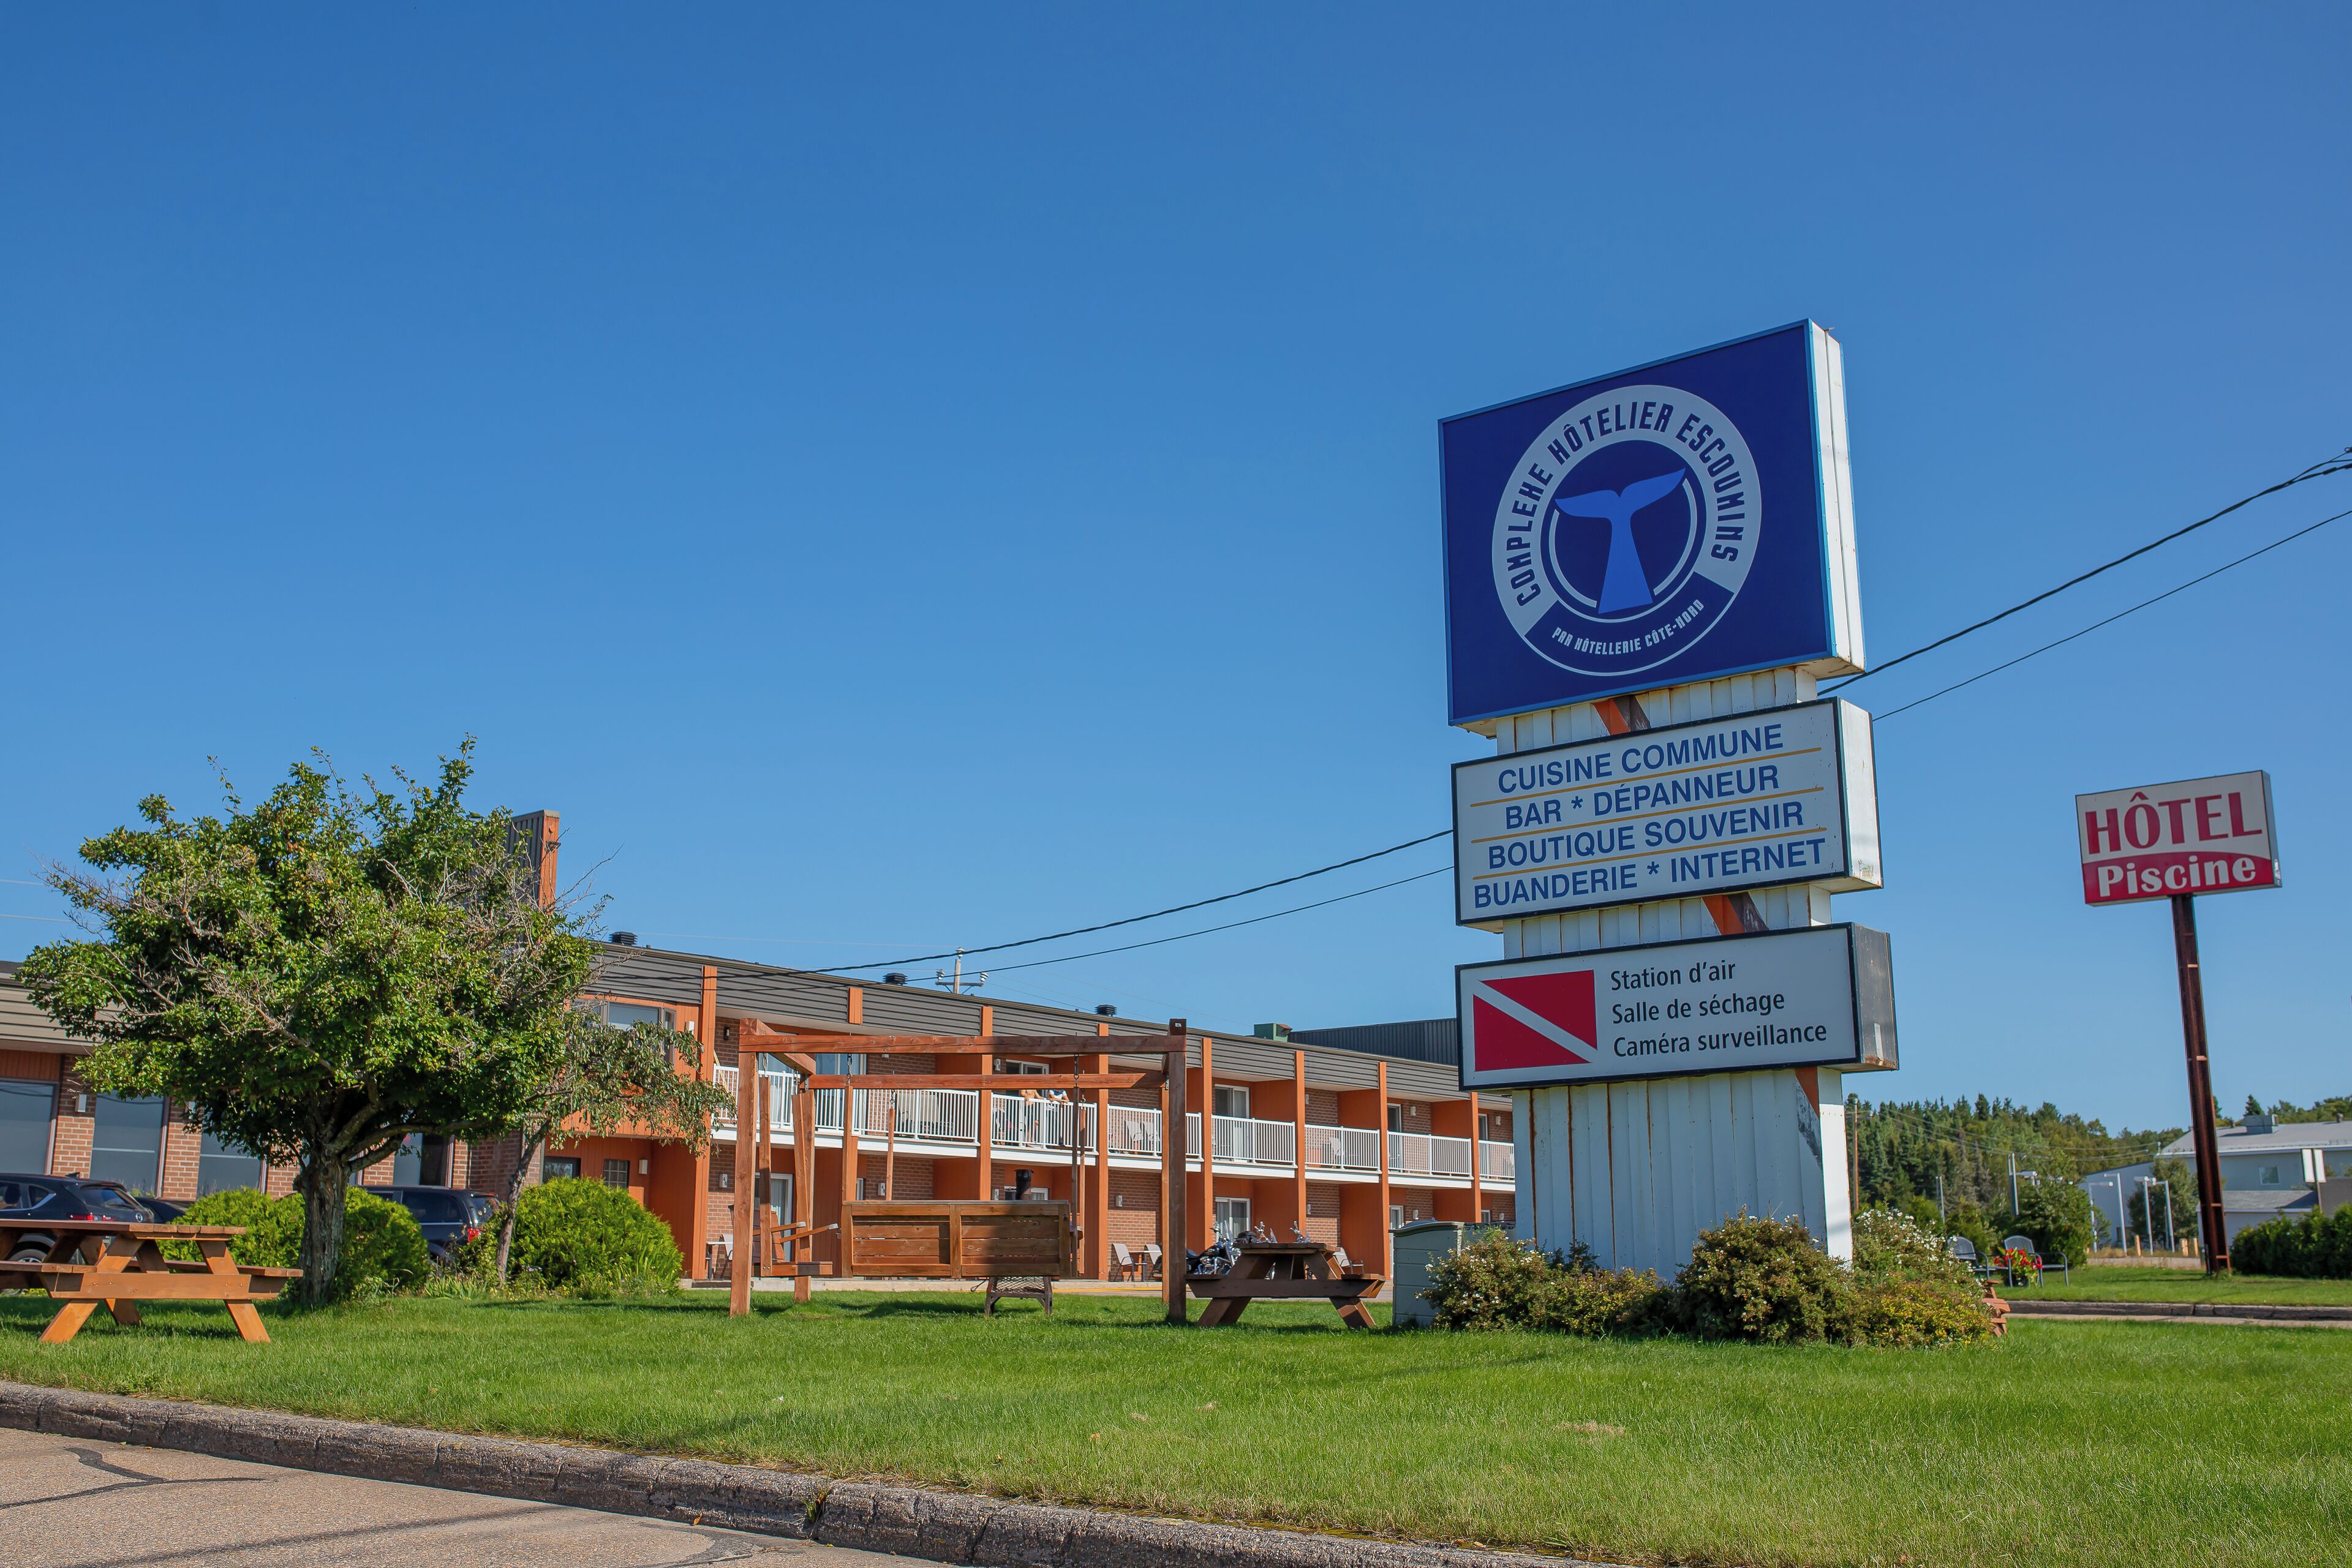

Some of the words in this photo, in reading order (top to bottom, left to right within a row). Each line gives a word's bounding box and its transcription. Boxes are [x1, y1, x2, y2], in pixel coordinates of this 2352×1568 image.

[1547, 401, 1674, 466] HÔTELIER
[1675, 412, 1746, 562] ESCOUMINS
[1551, 627, 1574, 647] PAR
[1574, 638, 1642, 655] HÔTELLERIE
[1645, 599, 1705, 647] CÔTE-NORD
[1498, 752, 1613, 794] CUISINE
[1621, 723, 1784, 774] COMMUNE
[1506, 799, 1562, 830] BAR
[1594, 764, 1779, 816] DÉPANNEUR
[2085, 791, 2263, 854] HÔTEL
[1488, 825, 1635, 870] BOUTIQUE
[1645, 800, 1804, 847] SOUVENIR
[1474, 863, 1638, 909] BUANDERIE
[1670, 838, 1826, 883] INTERNET
[2097, 855, 2256, 897] Piscine
[1610, 967, 1681, 991] Station
[1689, 959, 1736, 983] d'air
[1612, 1001, 1659, 1024] Salle
[1667, 998, 1692, 1019] de
[1699, 993, 1785, 1017] séchage
[1613, 1032, 1690, 1057] Caméra
[1698, 1024, 1827, 1051] surveillance
